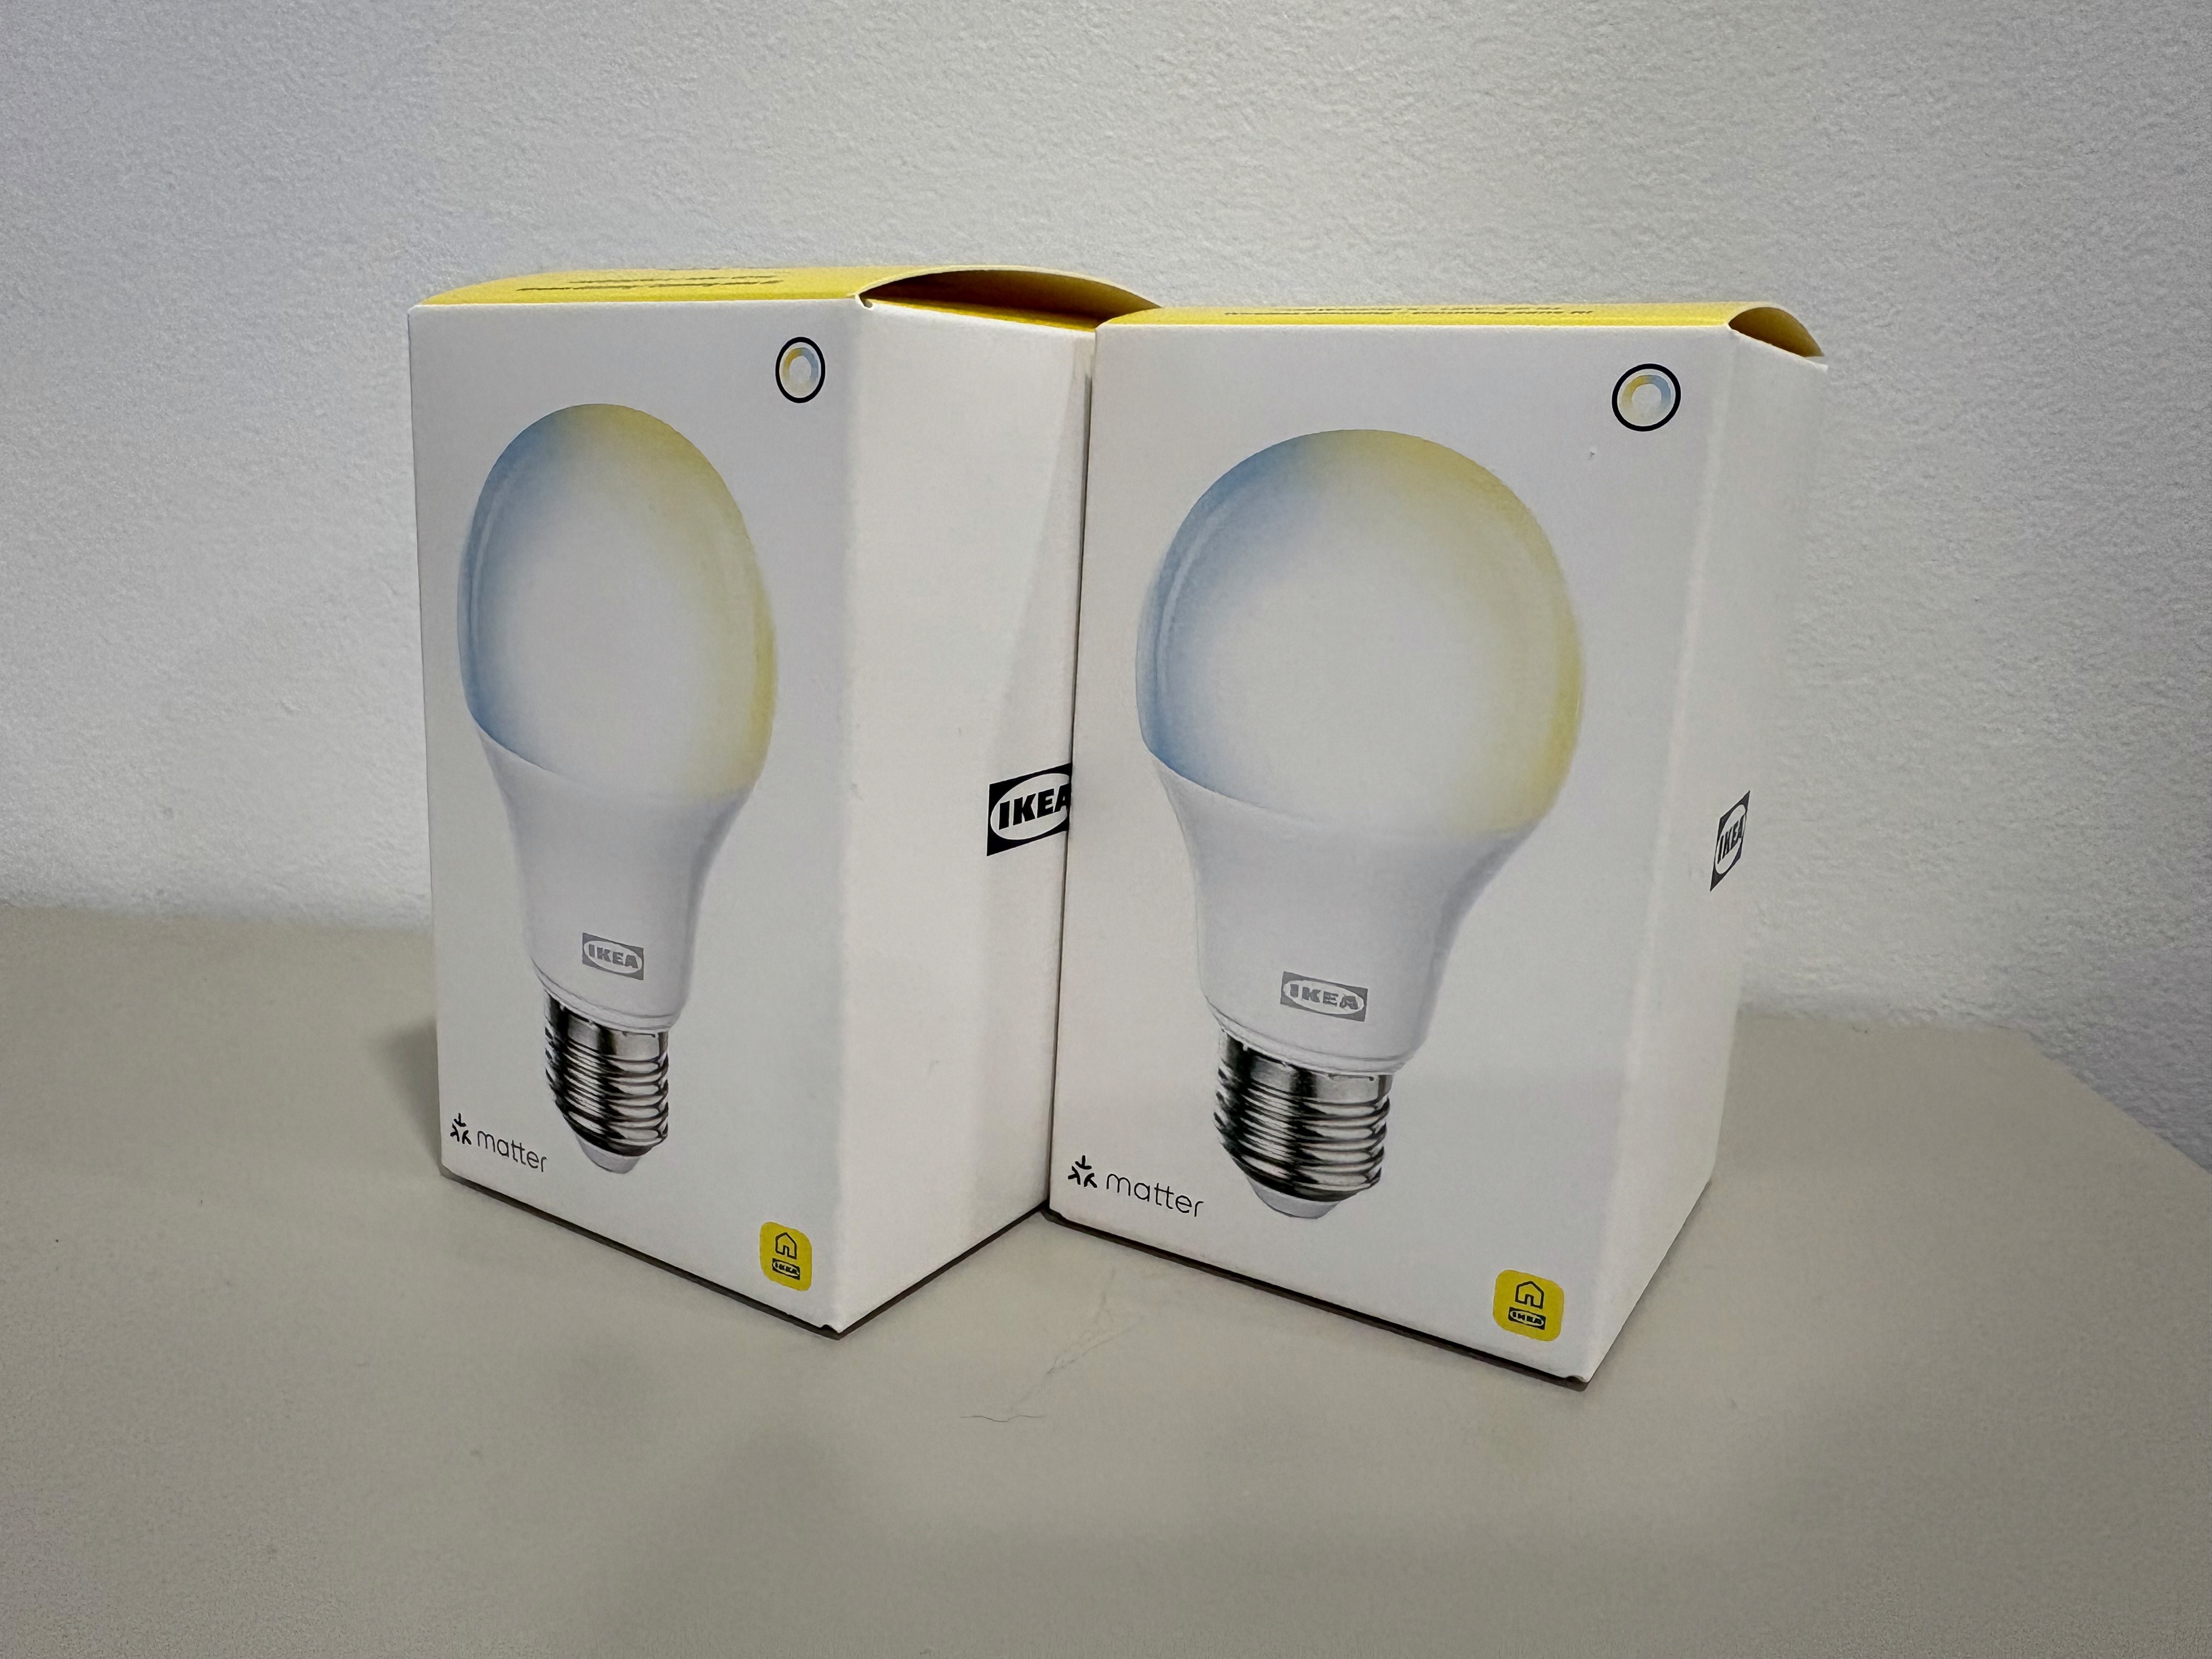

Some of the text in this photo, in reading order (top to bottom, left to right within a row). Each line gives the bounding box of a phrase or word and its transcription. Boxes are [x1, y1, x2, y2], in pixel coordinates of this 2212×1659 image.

[997, 783, 1071, 831] IKEA
[588, 943, 639, 970] IKEA
[1289, 983, 1359, 1011] IKEA
[477, 1130, 548, 1172] matter
[1105, 1173, 1204, 1217] matter
